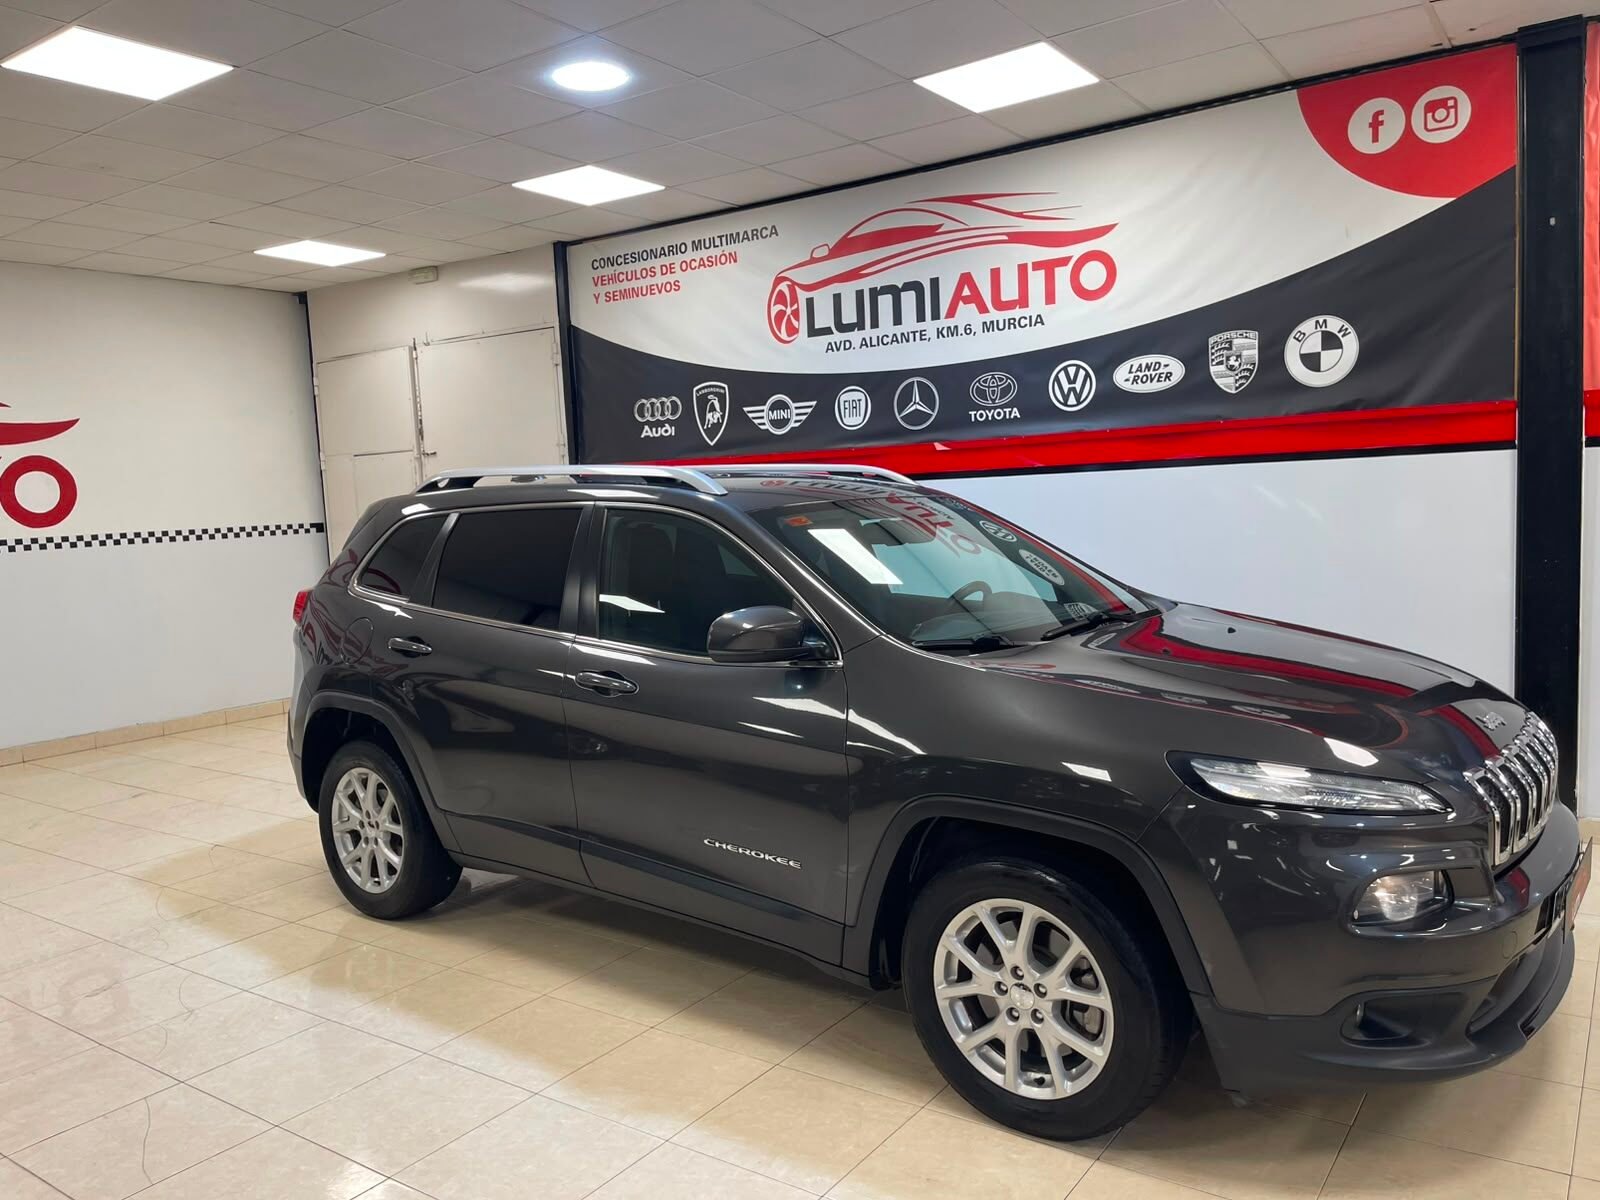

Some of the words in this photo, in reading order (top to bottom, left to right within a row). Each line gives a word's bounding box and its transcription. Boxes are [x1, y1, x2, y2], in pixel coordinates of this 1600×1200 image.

[591, 242, 688, 270] CONCESIONARIO
[692, 225, 779, 252] MULTIMARCA
[592, 266, 656, 287] VEHÍCULOS
[660, 263, 676, 276] DE
[679, 251, 738, 273] OCASIÓN
[593, 292, 601, 304] Y
[604, 280, 681, 303] SEMINUEVOS
[825, 336, 856, 353] AVD.
[859, 329, 931, 349] ALICANTE,
[936, 322, 978, 339] KM.6,
[981, 313, 1045, 334] MURCIA
[1210, 331, 1257, 344] PORSCHE
[768, 409, 791, 421] MINI
[843, 398, 862, 418] FIAT
[968, 407, 1021, 422] TOYOTA
[640, 423, 676, 438] Audi
[703, 838, 801, 869] CHEROKEE
